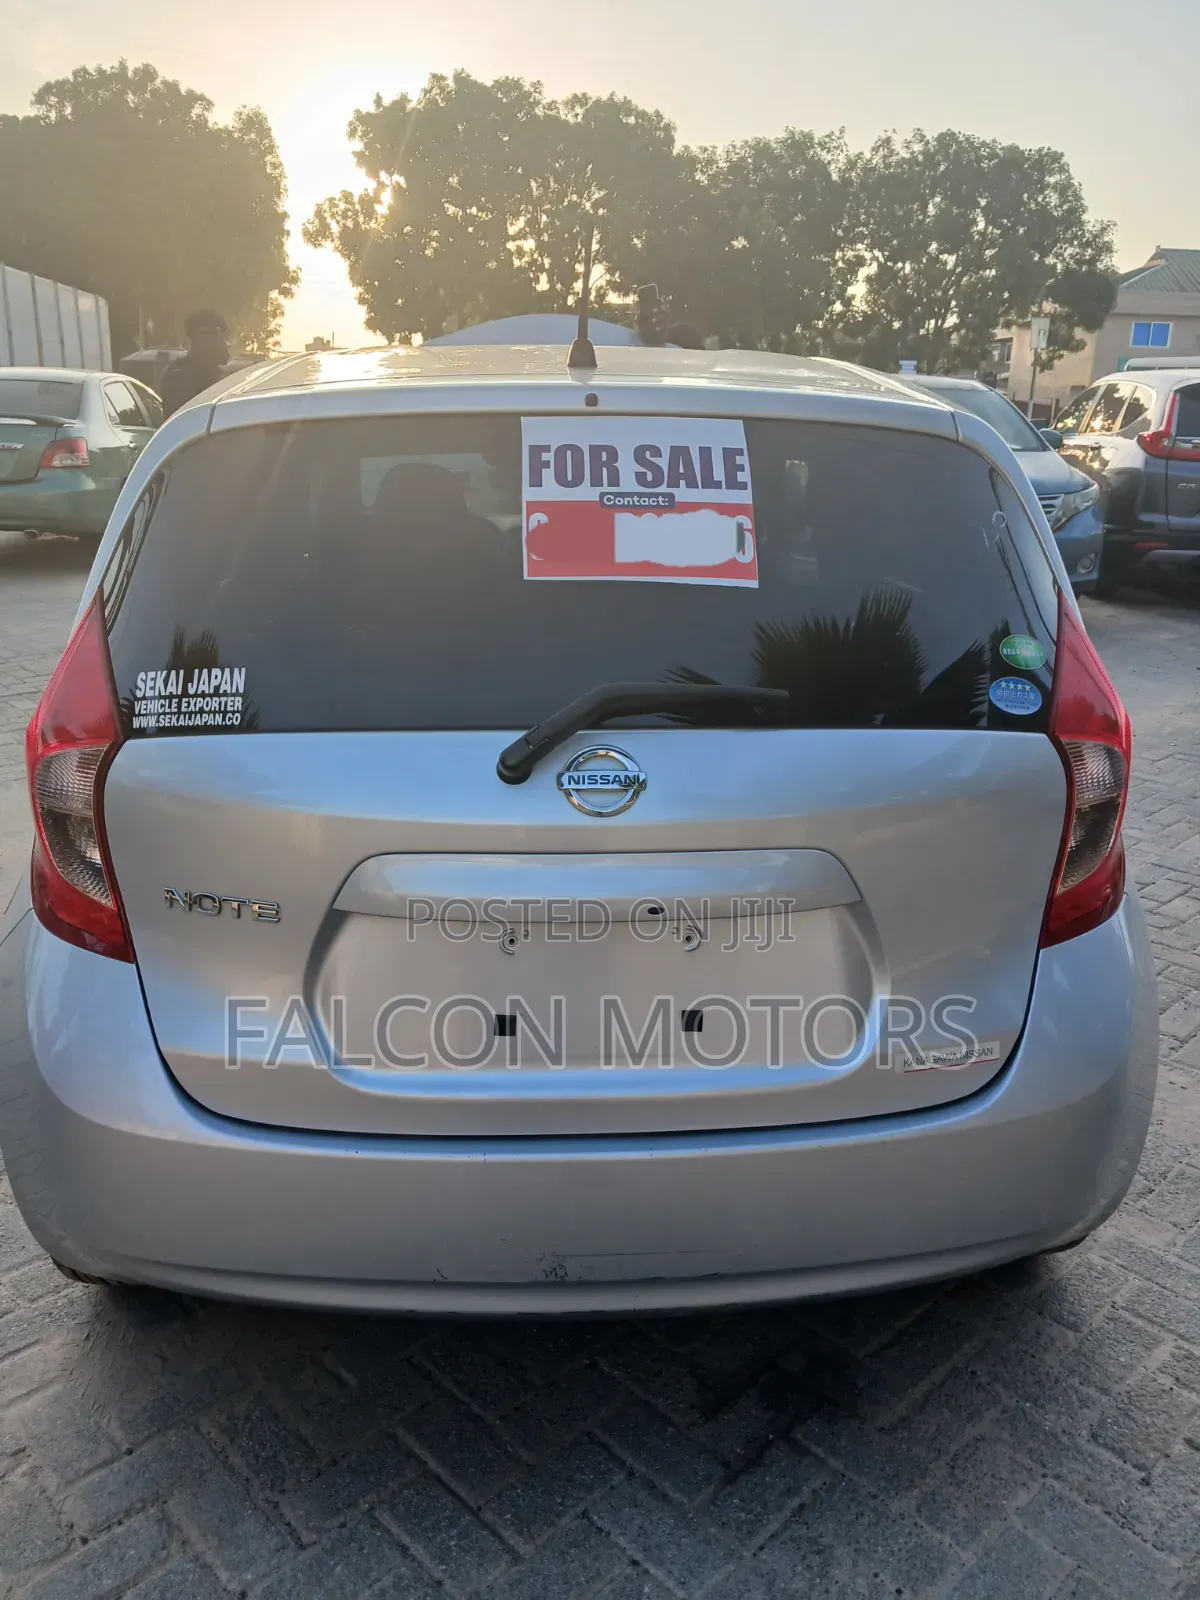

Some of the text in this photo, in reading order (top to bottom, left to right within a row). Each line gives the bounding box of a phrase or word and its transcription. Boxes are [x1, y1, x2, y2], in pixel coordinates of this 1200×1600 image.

[528, 443, 748, 490] FOR SALE
[603, 494, 669, 506] Contact:
[135, 667, 246, 697] SEKAI JAPAN
[134, 697, 242, 714] VEHICLE EXPORTER
[132, 713, 241, 728] WWW.SEKAIJAPAN.CO
[567, 774, 640, 786] NISSAN
[164, 887, 281, 922] NOTE
[903, 1047, 993, 1067] KANAGAWA NISSAN
